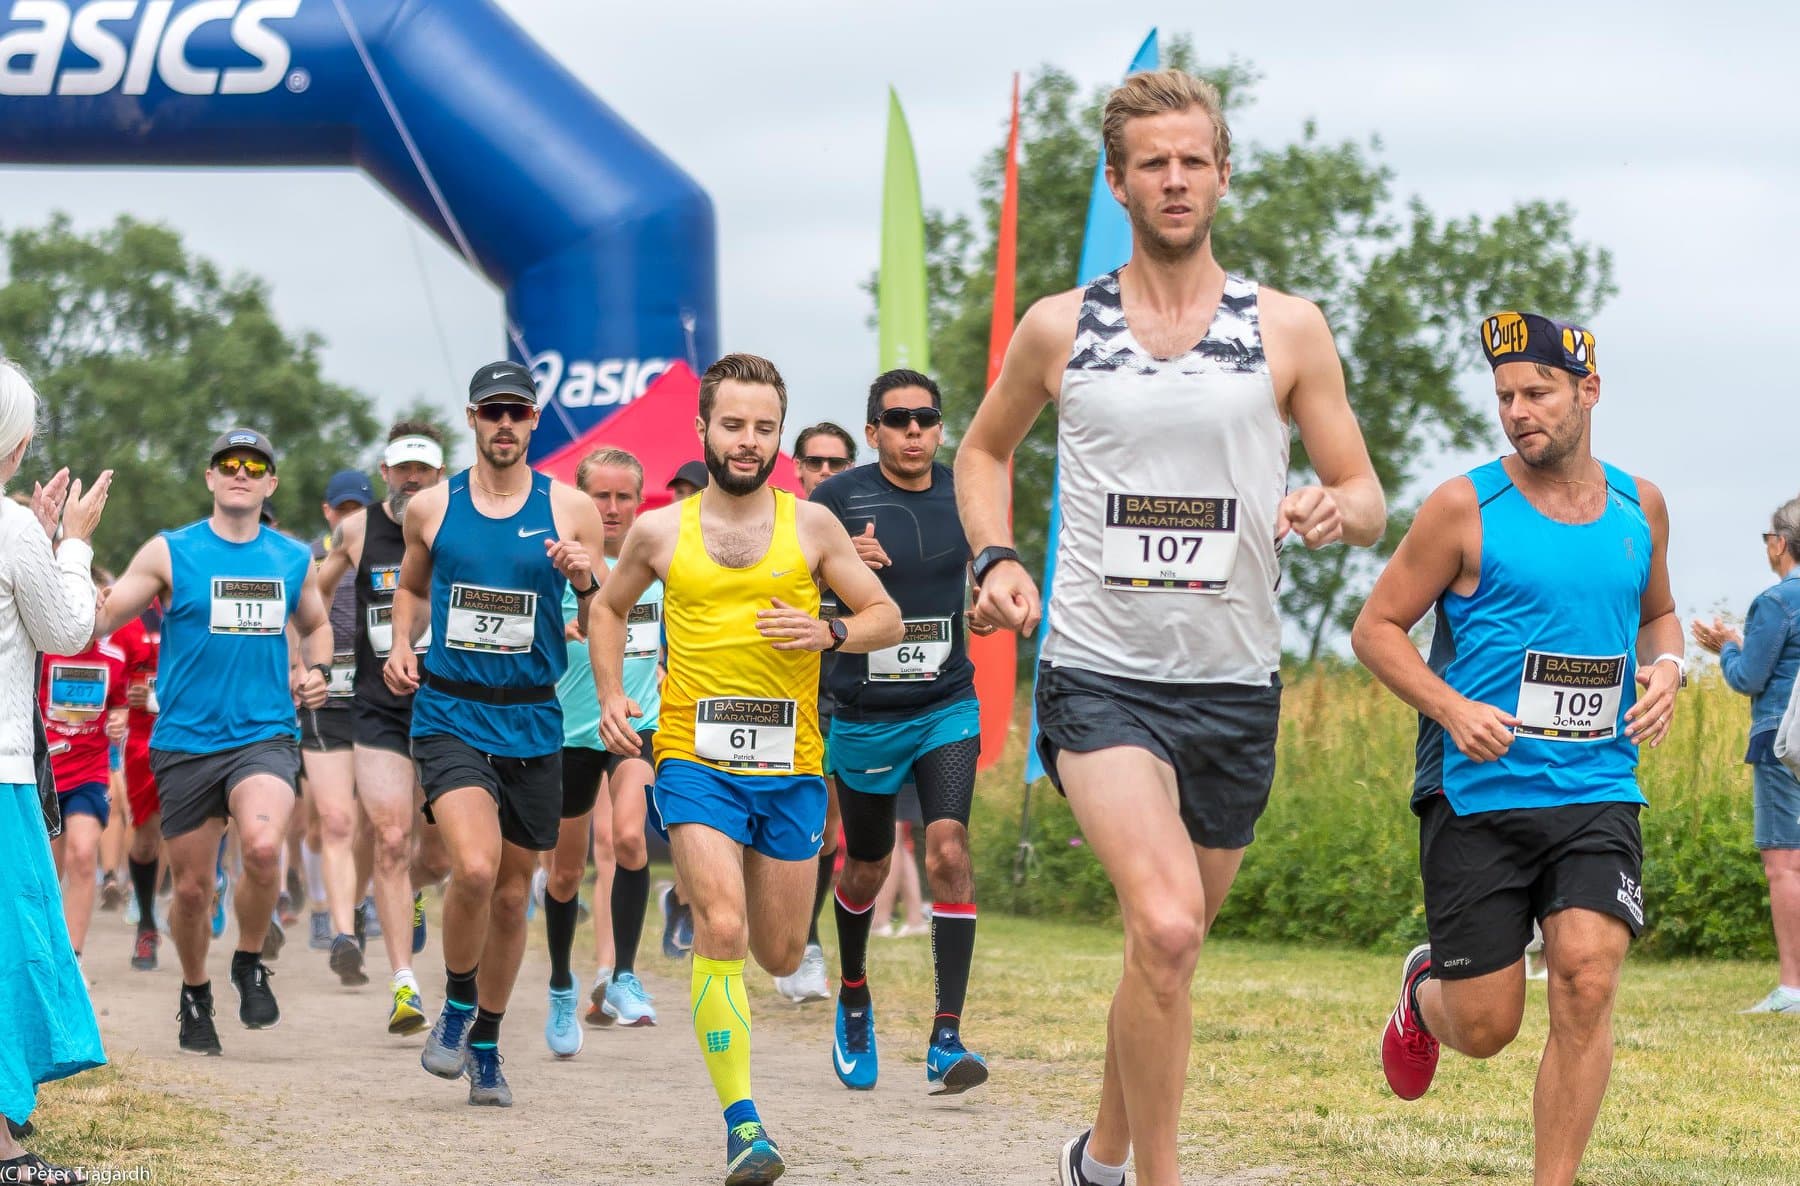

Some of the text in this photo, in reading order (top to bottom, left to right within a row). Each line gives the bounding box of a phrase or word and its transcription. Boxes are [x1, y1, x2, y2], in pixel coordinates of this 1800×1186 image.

[0, 0, 301, 95] asics
[559, 358, 674, 408] asic
[1126, 496, 1205, 514] BÅSTAD
[1125, 515, 1206, 528] MARATHON
[1205, 502, 1215, 528] 2019
[1138, 535, 1203, 564] 107
[235, 602, 263, 619] 111
[463, 601, 513, 613] MARATHON
[474, 614, 504, 635] 37
[904, 623, 931, 633] STAD
[897, 646, 926, 664] 64
[1546, 657, 1609, 674] BÅSTAD
[1543, 673, 1608, 685] MARATHON
[714, 699, 772, 714] BÅSTAD
[1554, 690, 1603, 717] 109
[713, 713, 772, 723] MARATHON
[729, 728, 757, 750] 61
[733, 753, 755, 761] Patrick
[1620, 871, 1644, 906] TEA
